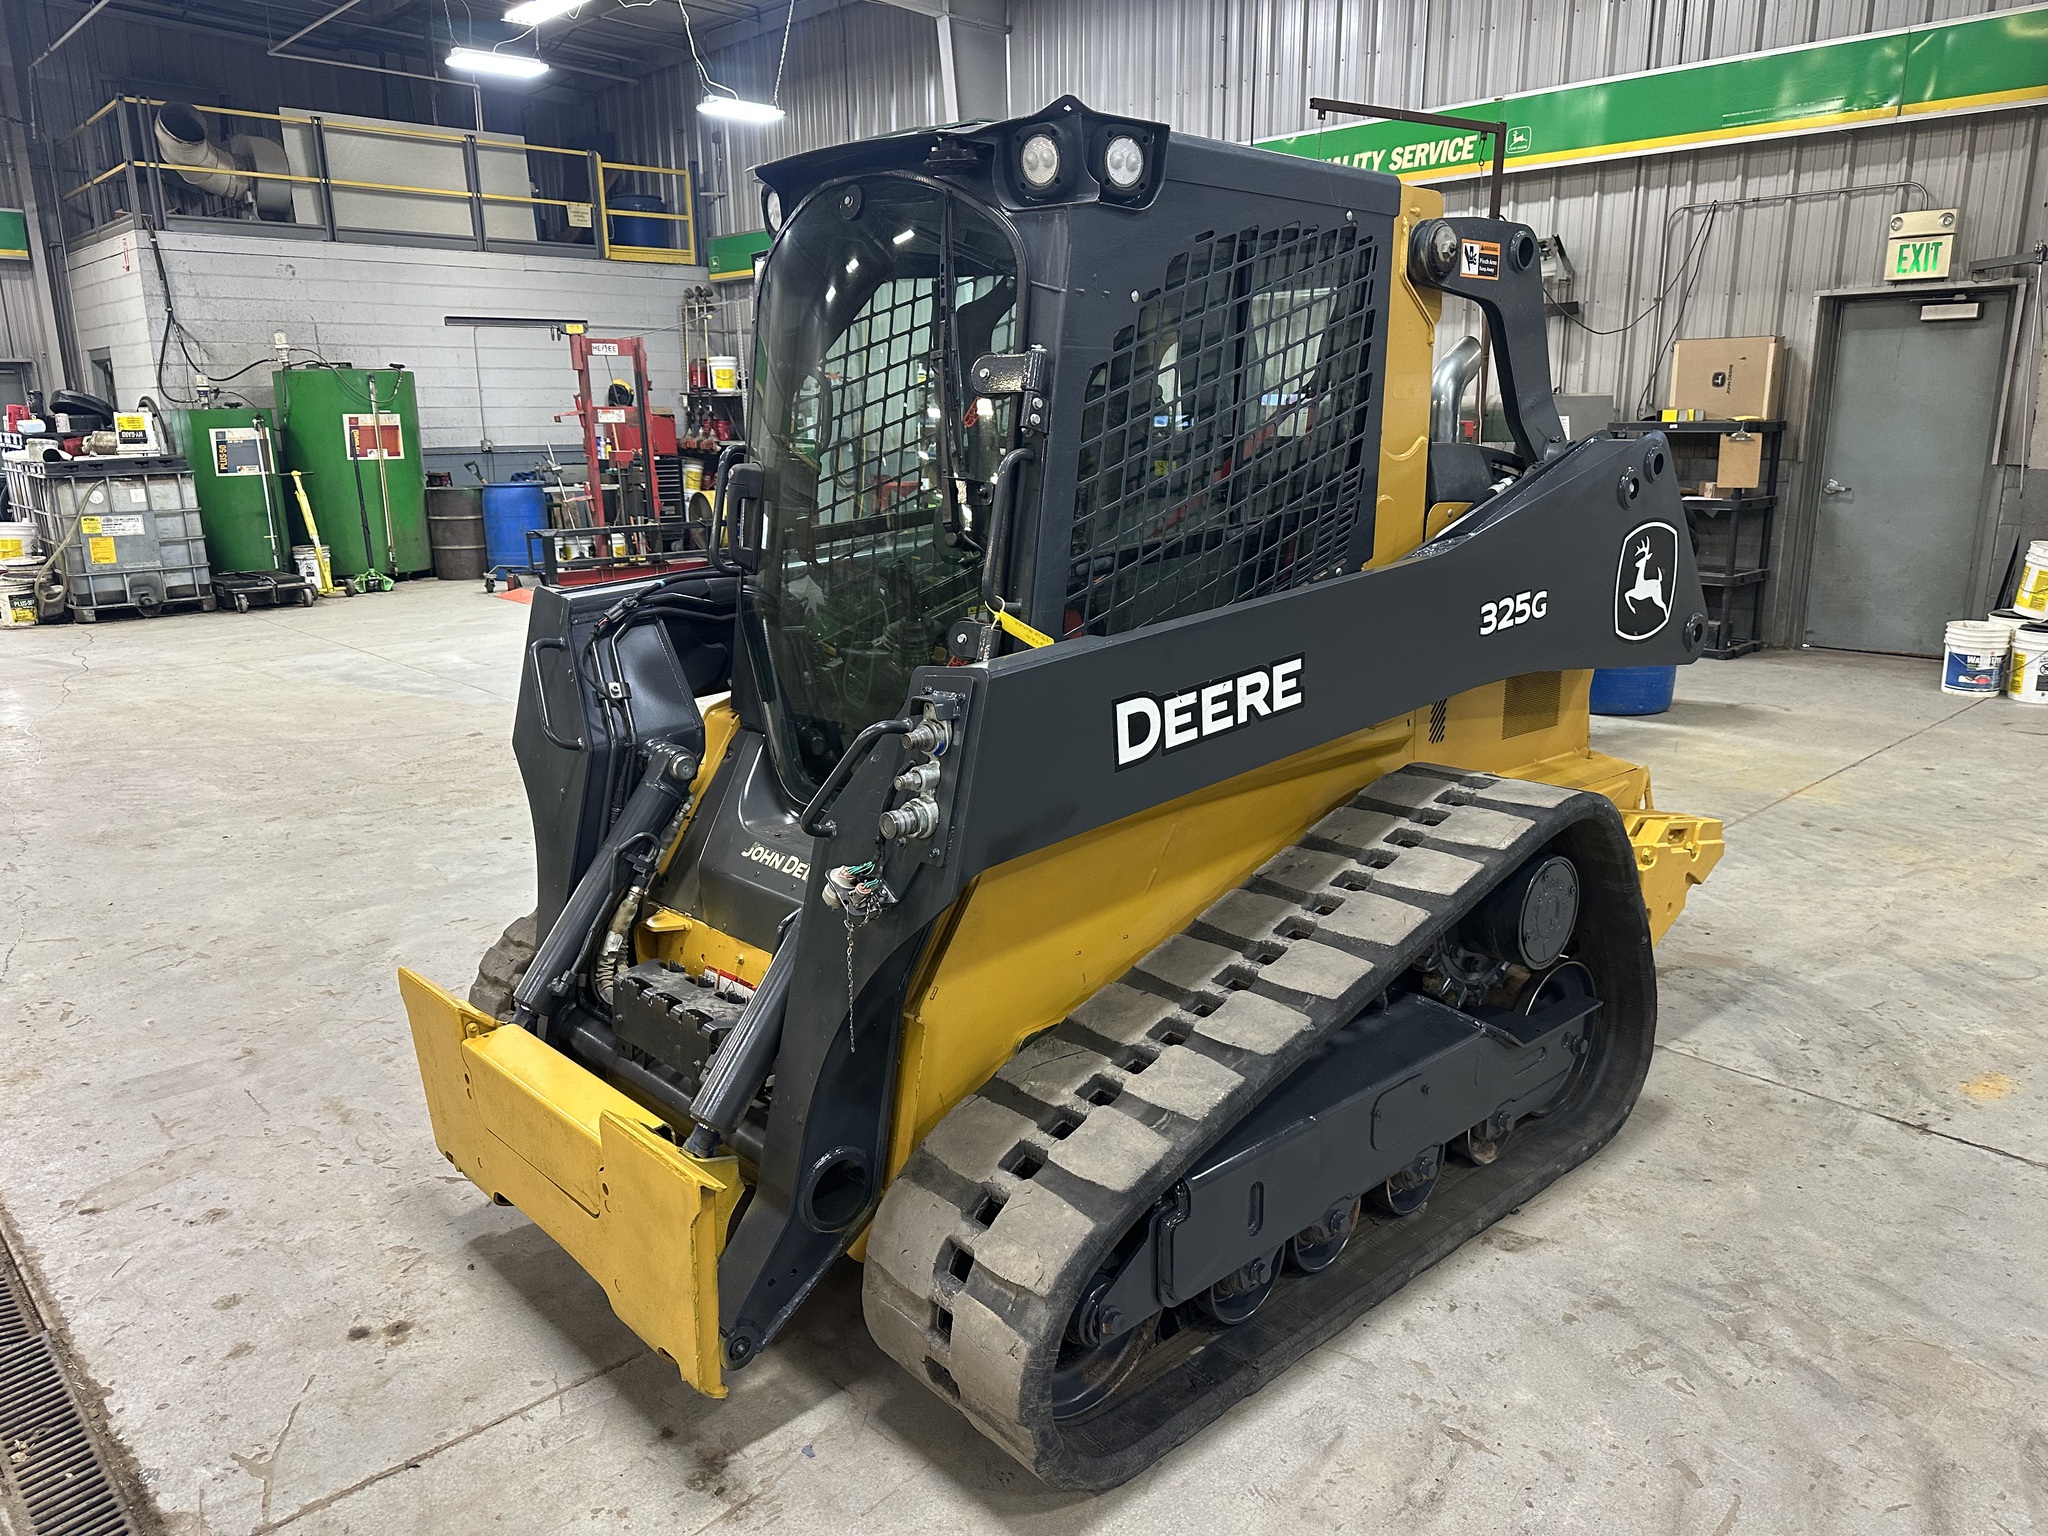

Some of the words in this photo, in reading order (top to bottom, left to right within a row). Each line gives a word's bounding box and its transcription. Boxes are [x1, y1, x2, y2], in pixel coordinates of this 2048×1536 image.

[1388, 134, 1478, 171] SERVICE
[1897, 241, 1943, 273] EXIT
[1480, 590, 1548, 636] 325G
[1115, 658, 1302, 765] DEERE
[741, 843, 786, 870] JOHN
